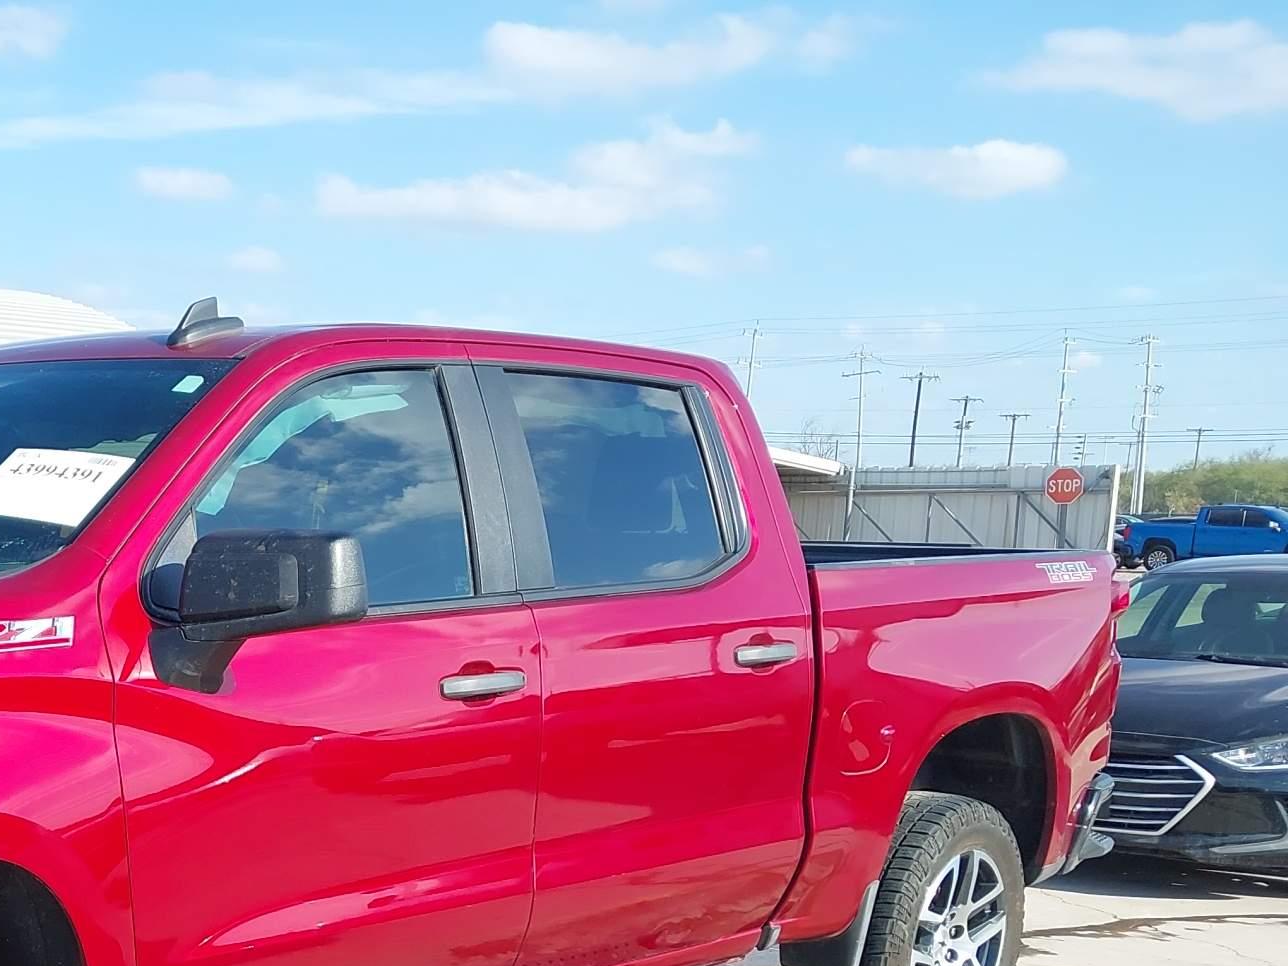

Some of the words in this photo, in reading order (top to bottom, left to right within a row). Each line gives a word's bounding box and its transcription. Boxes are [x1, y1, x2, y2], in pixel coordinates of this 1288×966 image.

[9, 462, 103, 483] 43994391
[1048, 478, 1081, 493] STOP
[1035, 561, 1097, 575] TRAIL
[1049, 571, 1093, 584] BOSS
